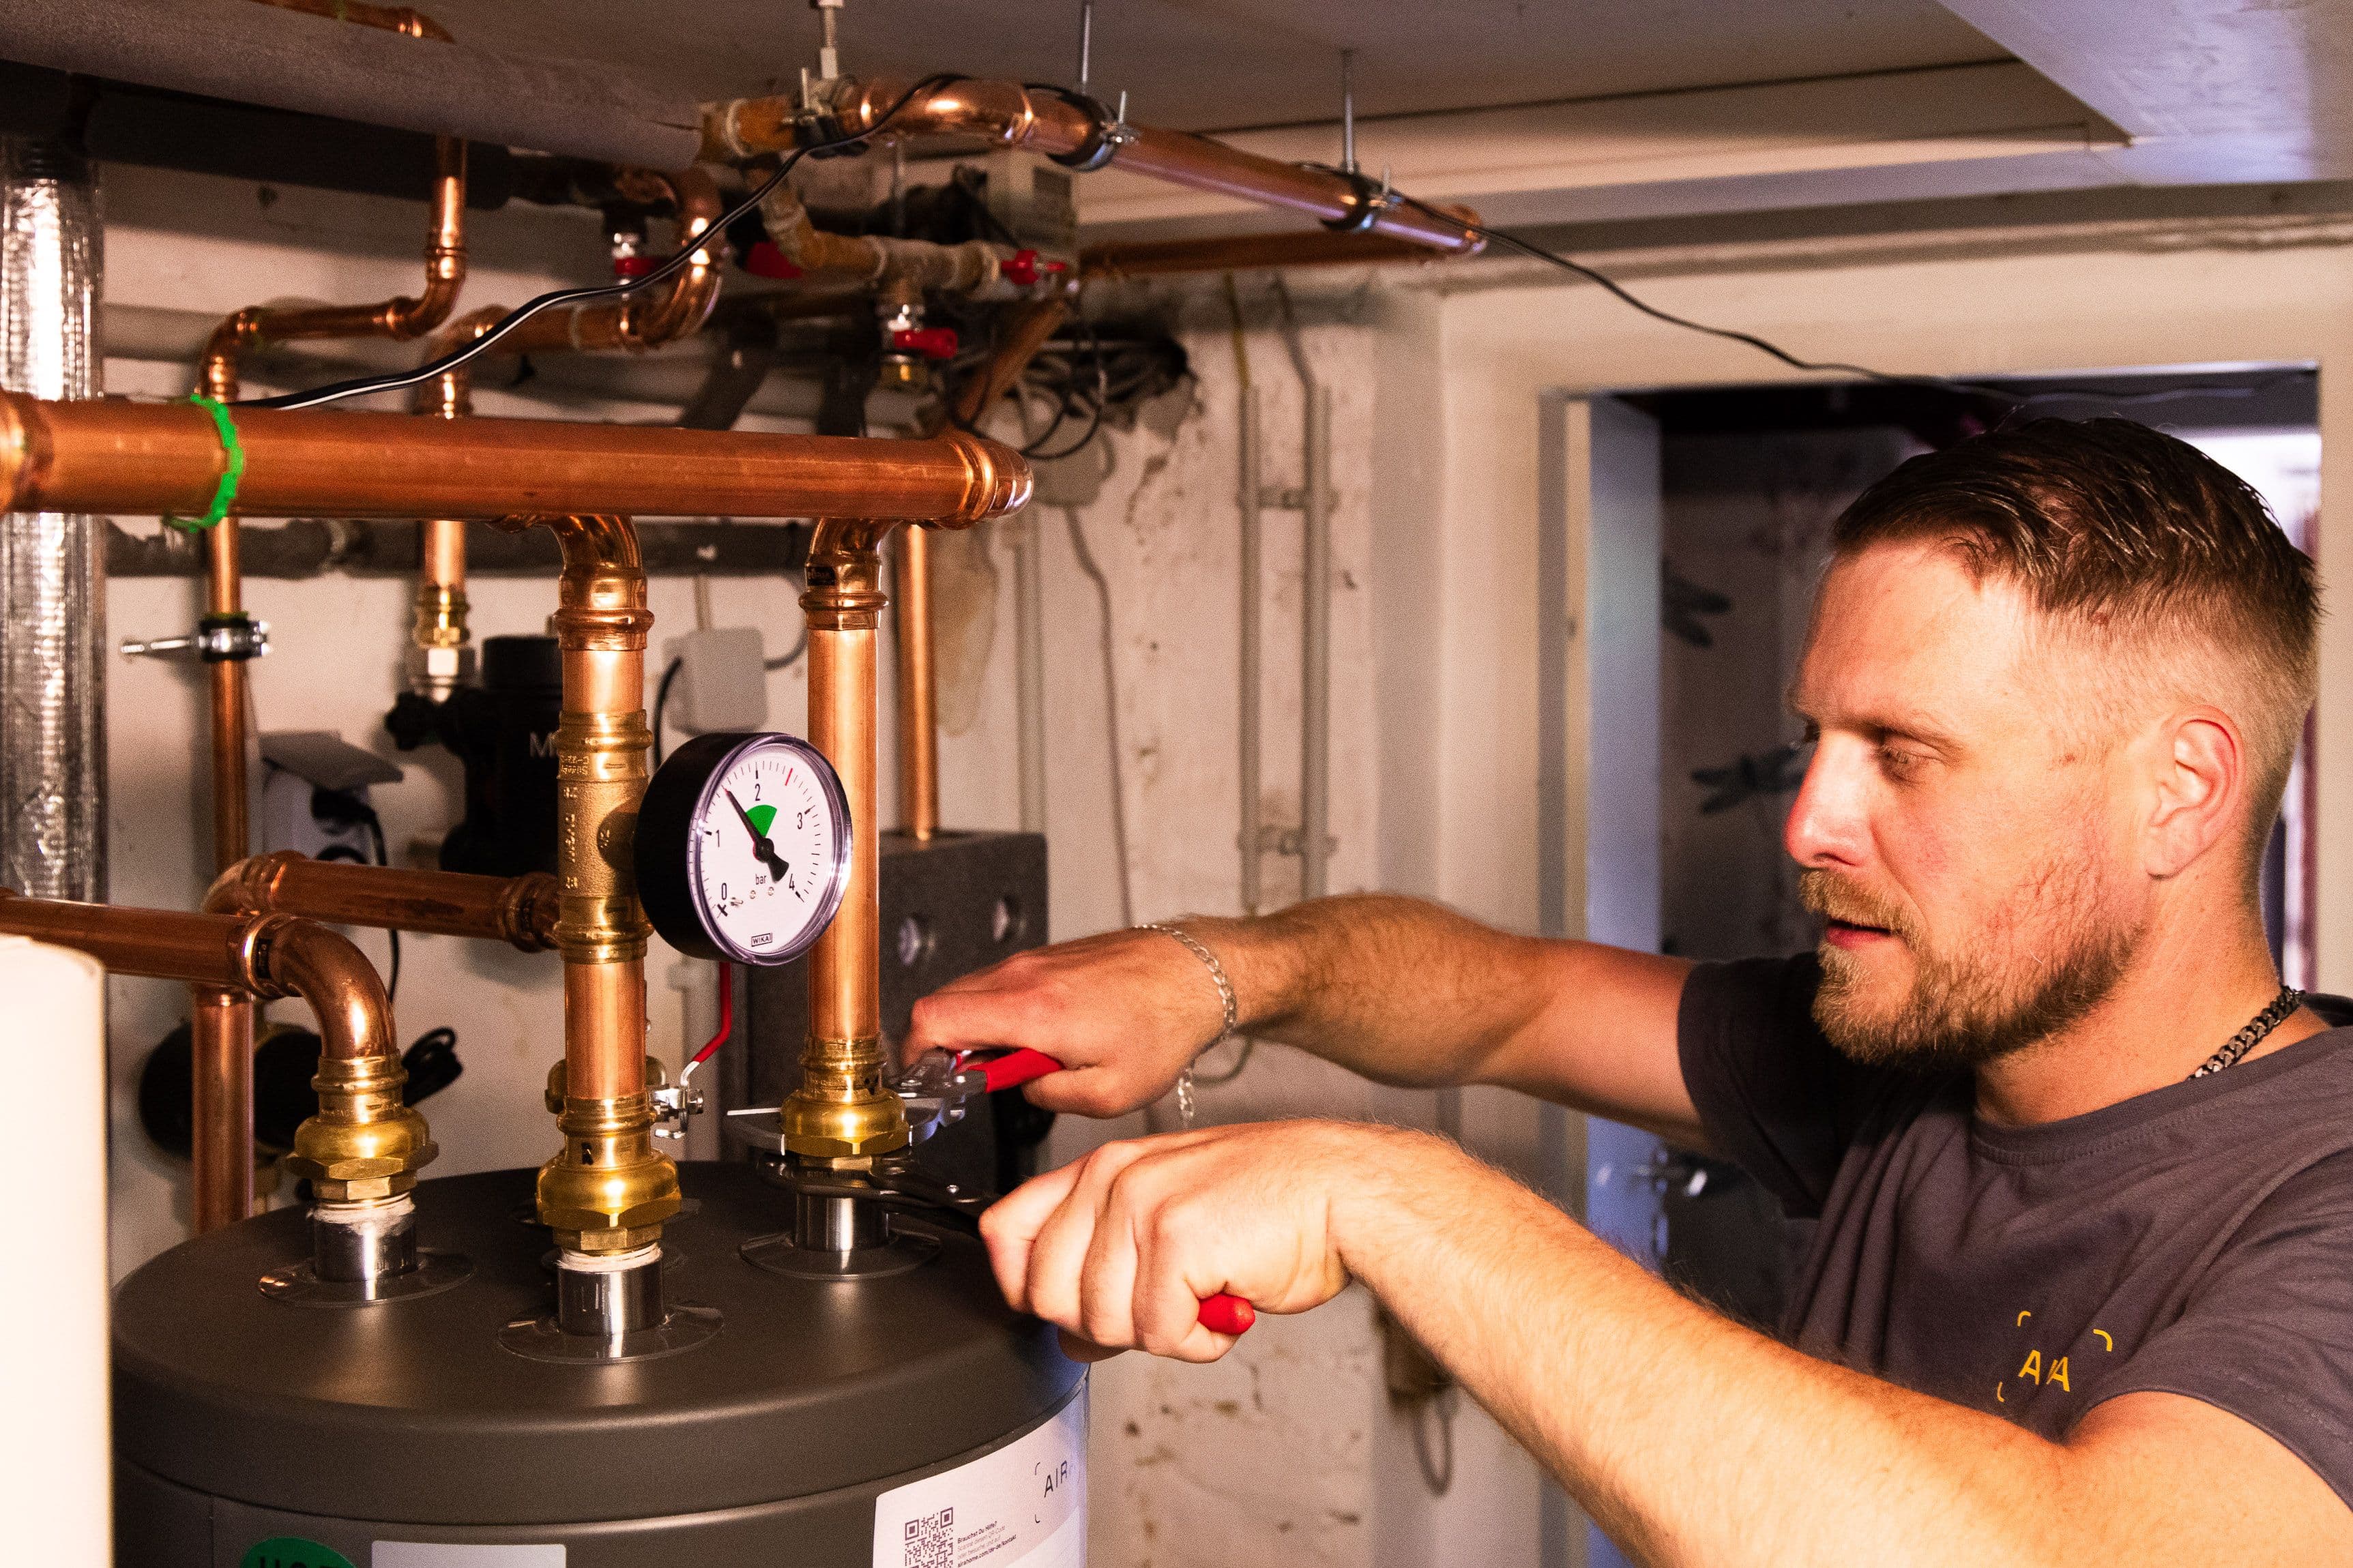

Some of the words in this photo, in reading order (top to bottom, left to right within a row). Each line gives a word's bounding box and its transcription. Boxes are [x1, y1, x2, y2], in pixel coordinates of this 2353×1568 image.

[755, 783, 761, 801] 2
[797, 812, 803, 829] 3
[716, 829, 720, 847] 1
[755, 874, 767, 885] bar
[789, 873, 795, 891] 4
[721, 883, 727, 900] 0
[752, 935, 770, 945] WIKA
